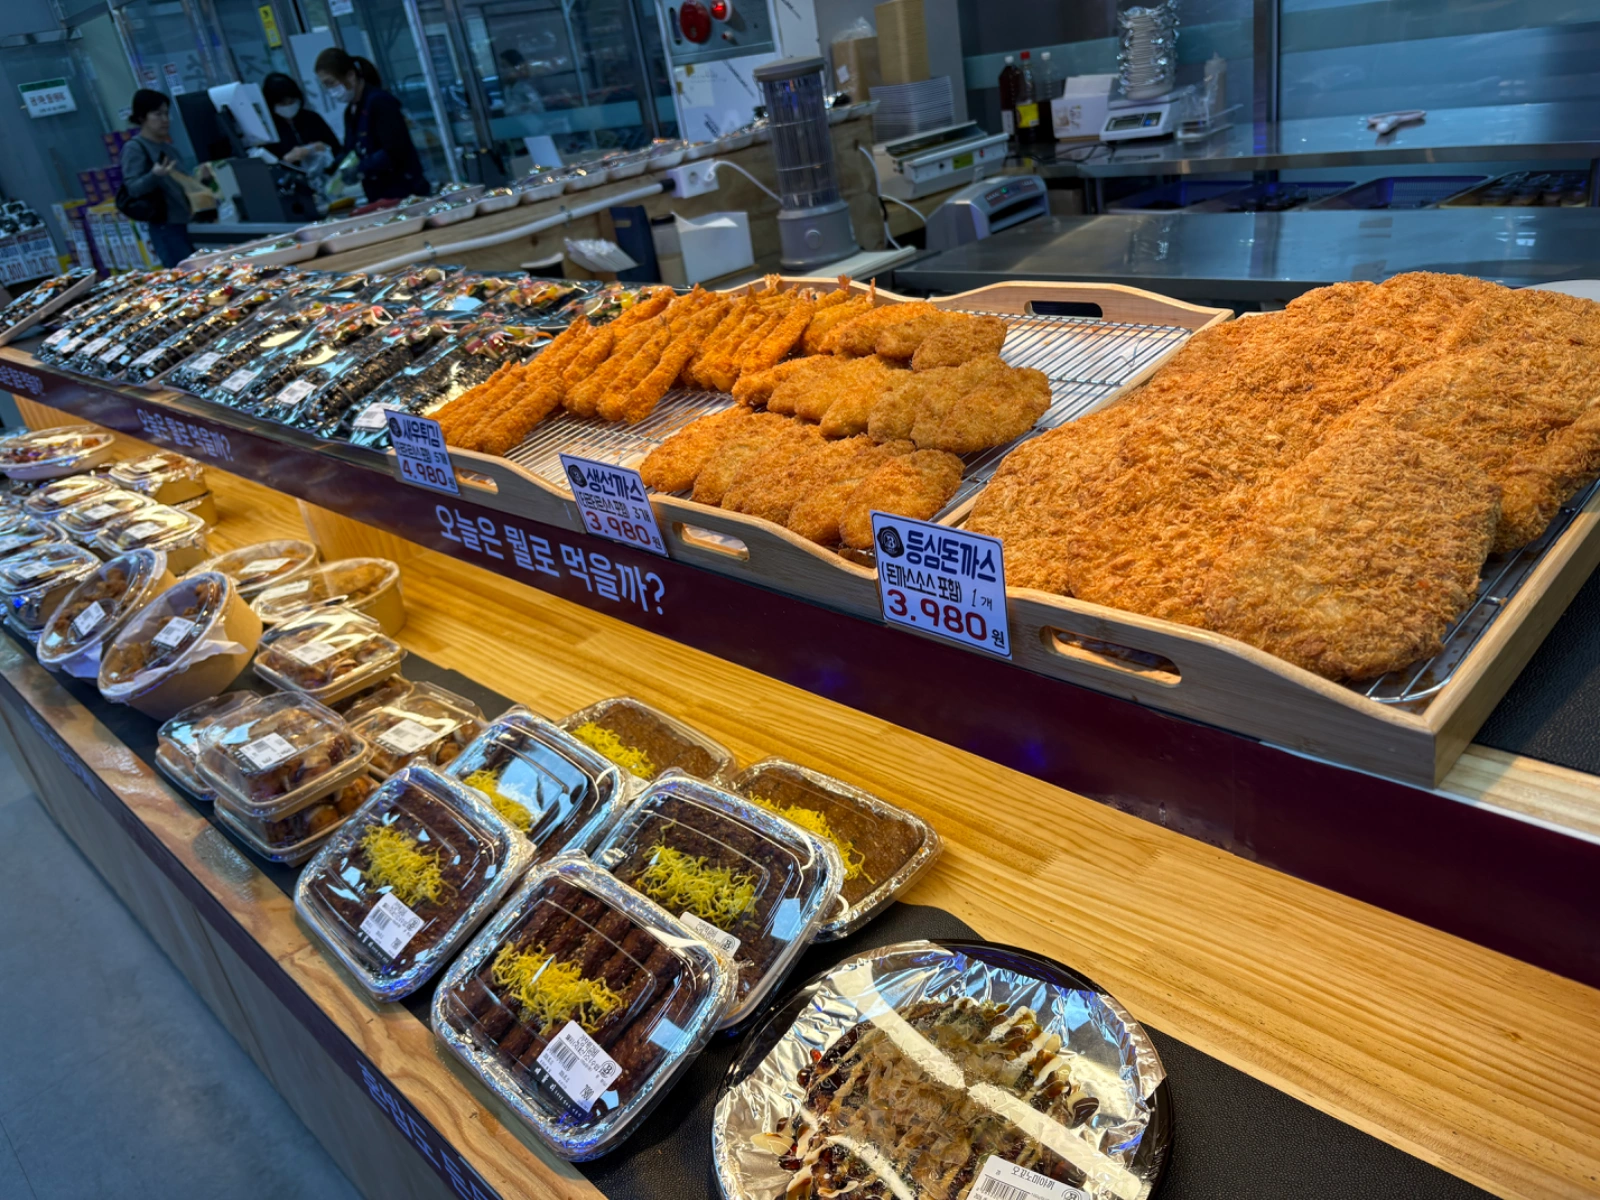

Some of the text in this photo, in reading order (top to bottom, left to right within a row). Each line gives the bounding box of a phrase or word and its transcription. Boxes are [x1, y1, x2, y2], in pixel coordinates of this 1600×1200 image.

[136, 408, 171, 441] 오늘은
[187, 424, 234, 462] 먹을까?
[402, 418, 441, 449] 새우튀김
[402, 459, 448, 486] 4.980
[586, 467, 645, 503] 생선까스
[585, 510, 663, 550] 3.980 원
[435, 504, 665, 616] 오늘은 뭘로 먹을까?
[905, 529, 997, 583] 등심돈까스
[887, 588, 1006, 650] 3.980 원
